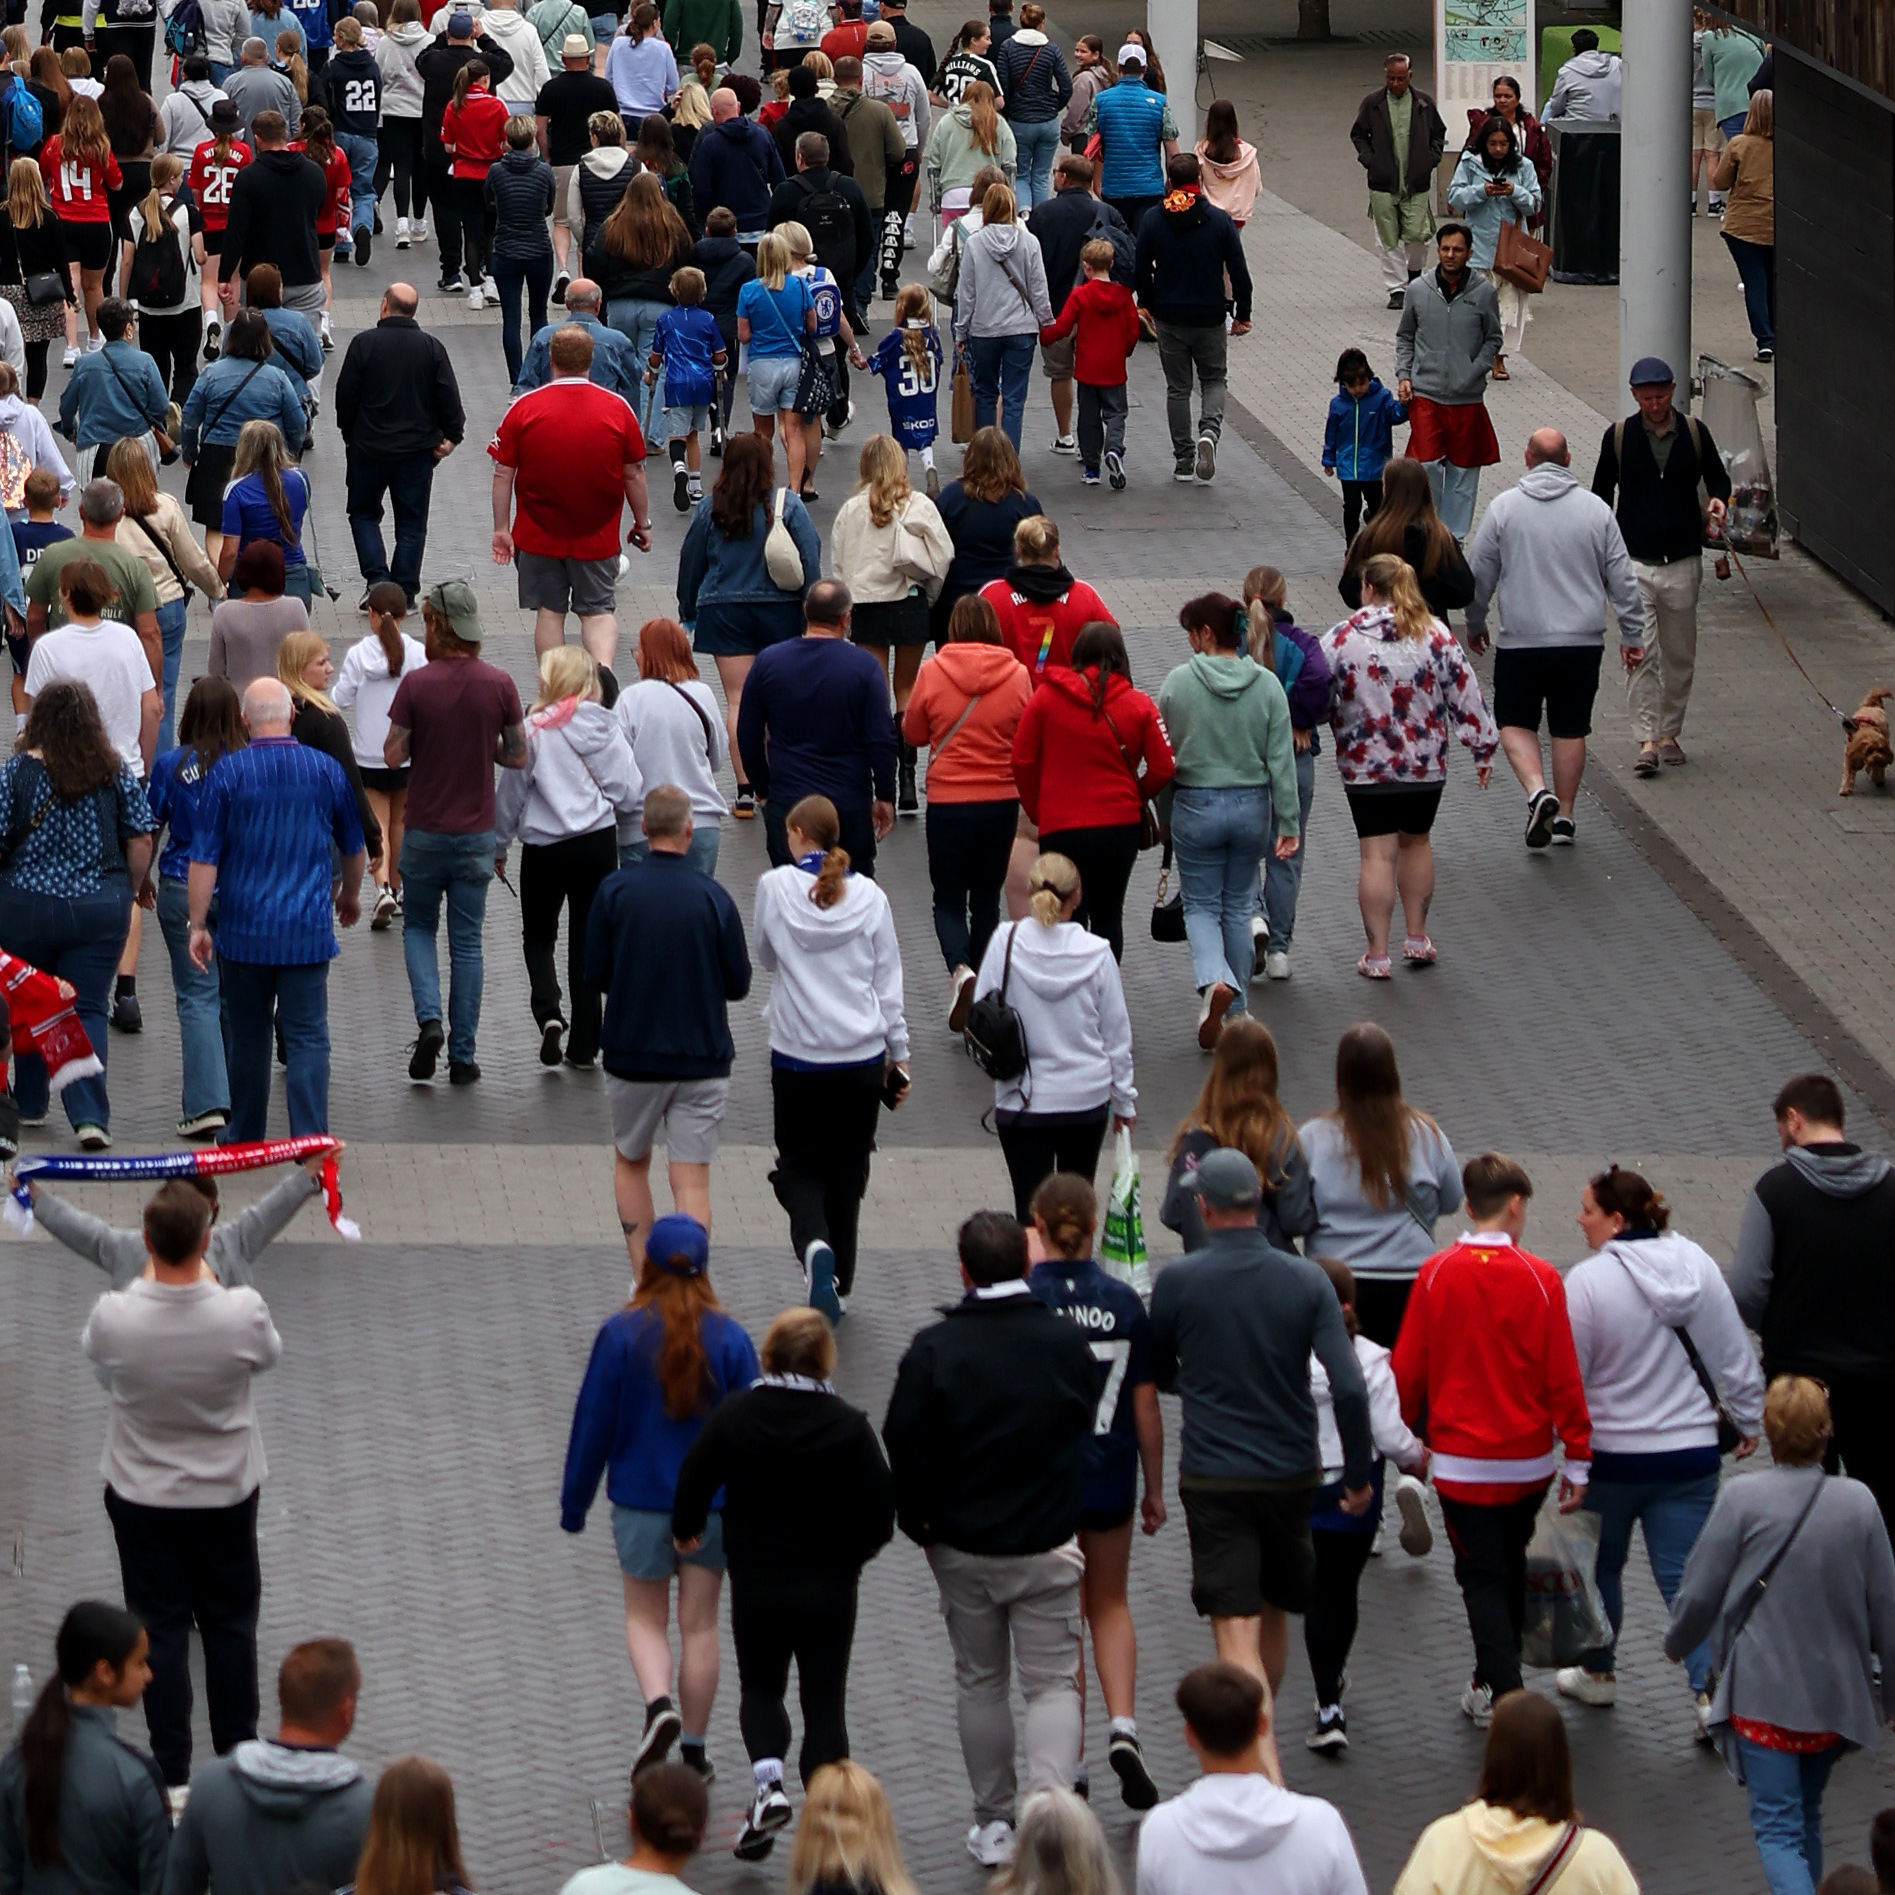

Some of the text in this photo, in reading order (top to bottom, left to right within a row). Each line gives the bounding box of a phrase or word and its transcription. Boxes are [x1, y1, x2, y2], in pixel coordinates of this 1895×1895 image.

[945, 60, 982, 76] WILLIAMS
[346, 80, 376, 111] 22
[60, 160, 92, 202] 14
[898, 350, 937, 397] 30
[1028, 616, 1055, 674] 7
